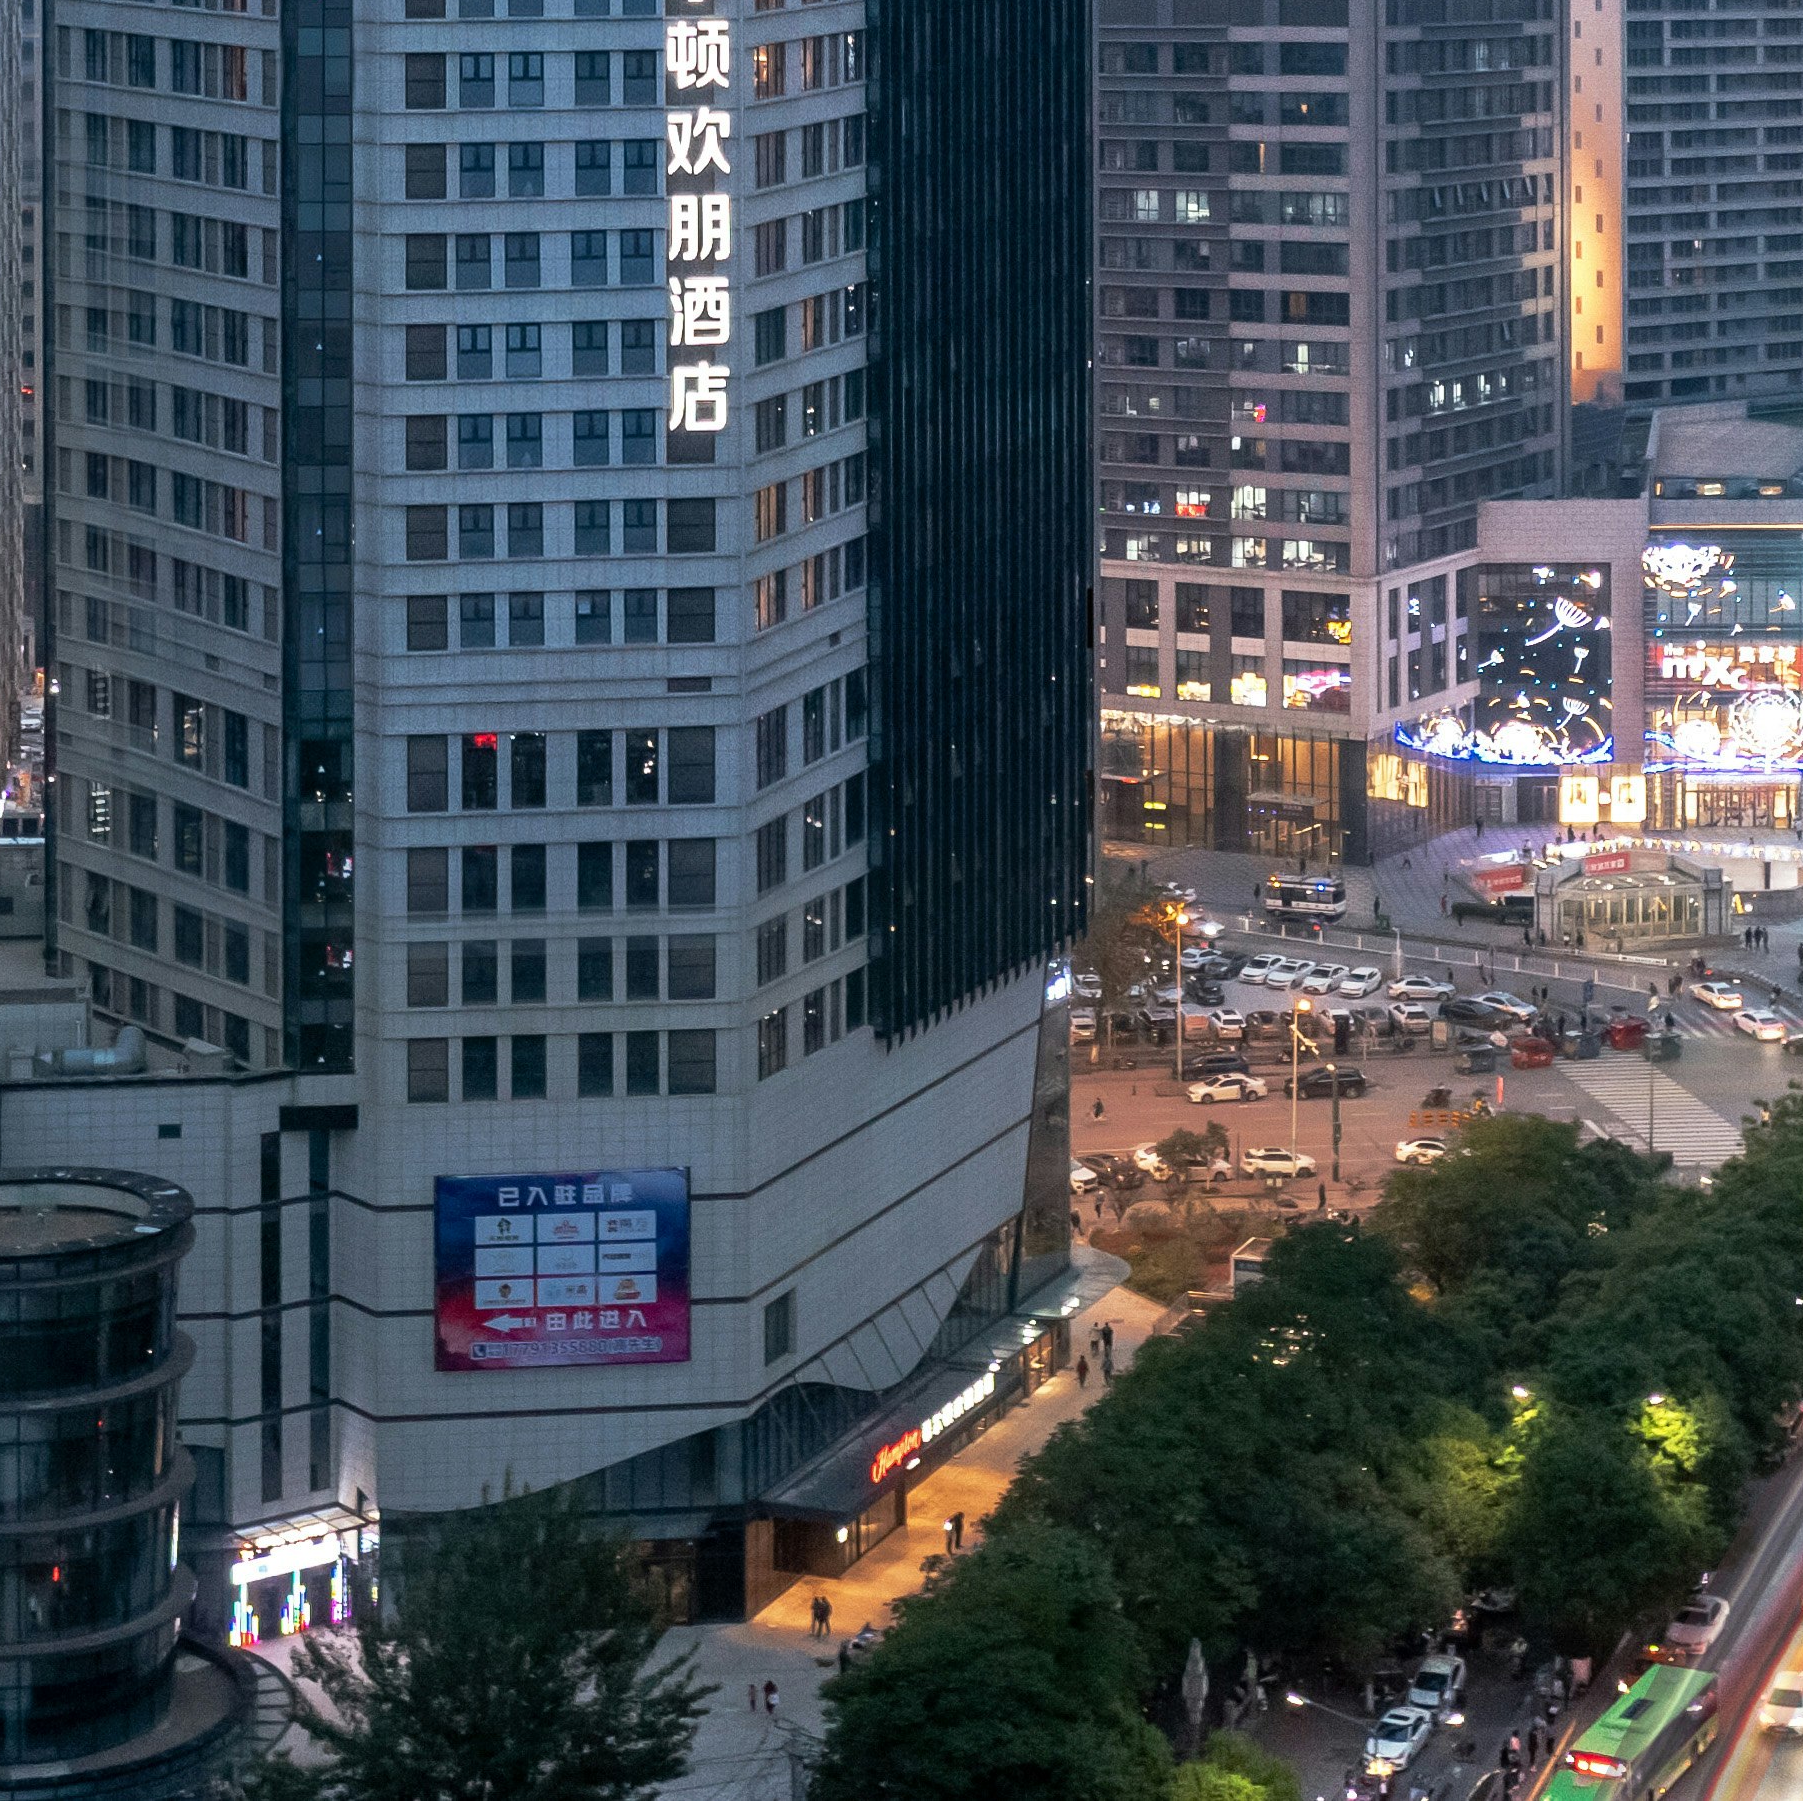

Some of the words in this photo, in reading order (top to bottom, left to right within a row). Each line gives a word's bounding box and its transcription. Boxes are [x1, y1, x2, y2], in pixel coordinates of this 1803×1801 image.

[499, 1184, 633, 1207] 已入驻品牌
[547, 1310, 647, 1331] 由此进入
